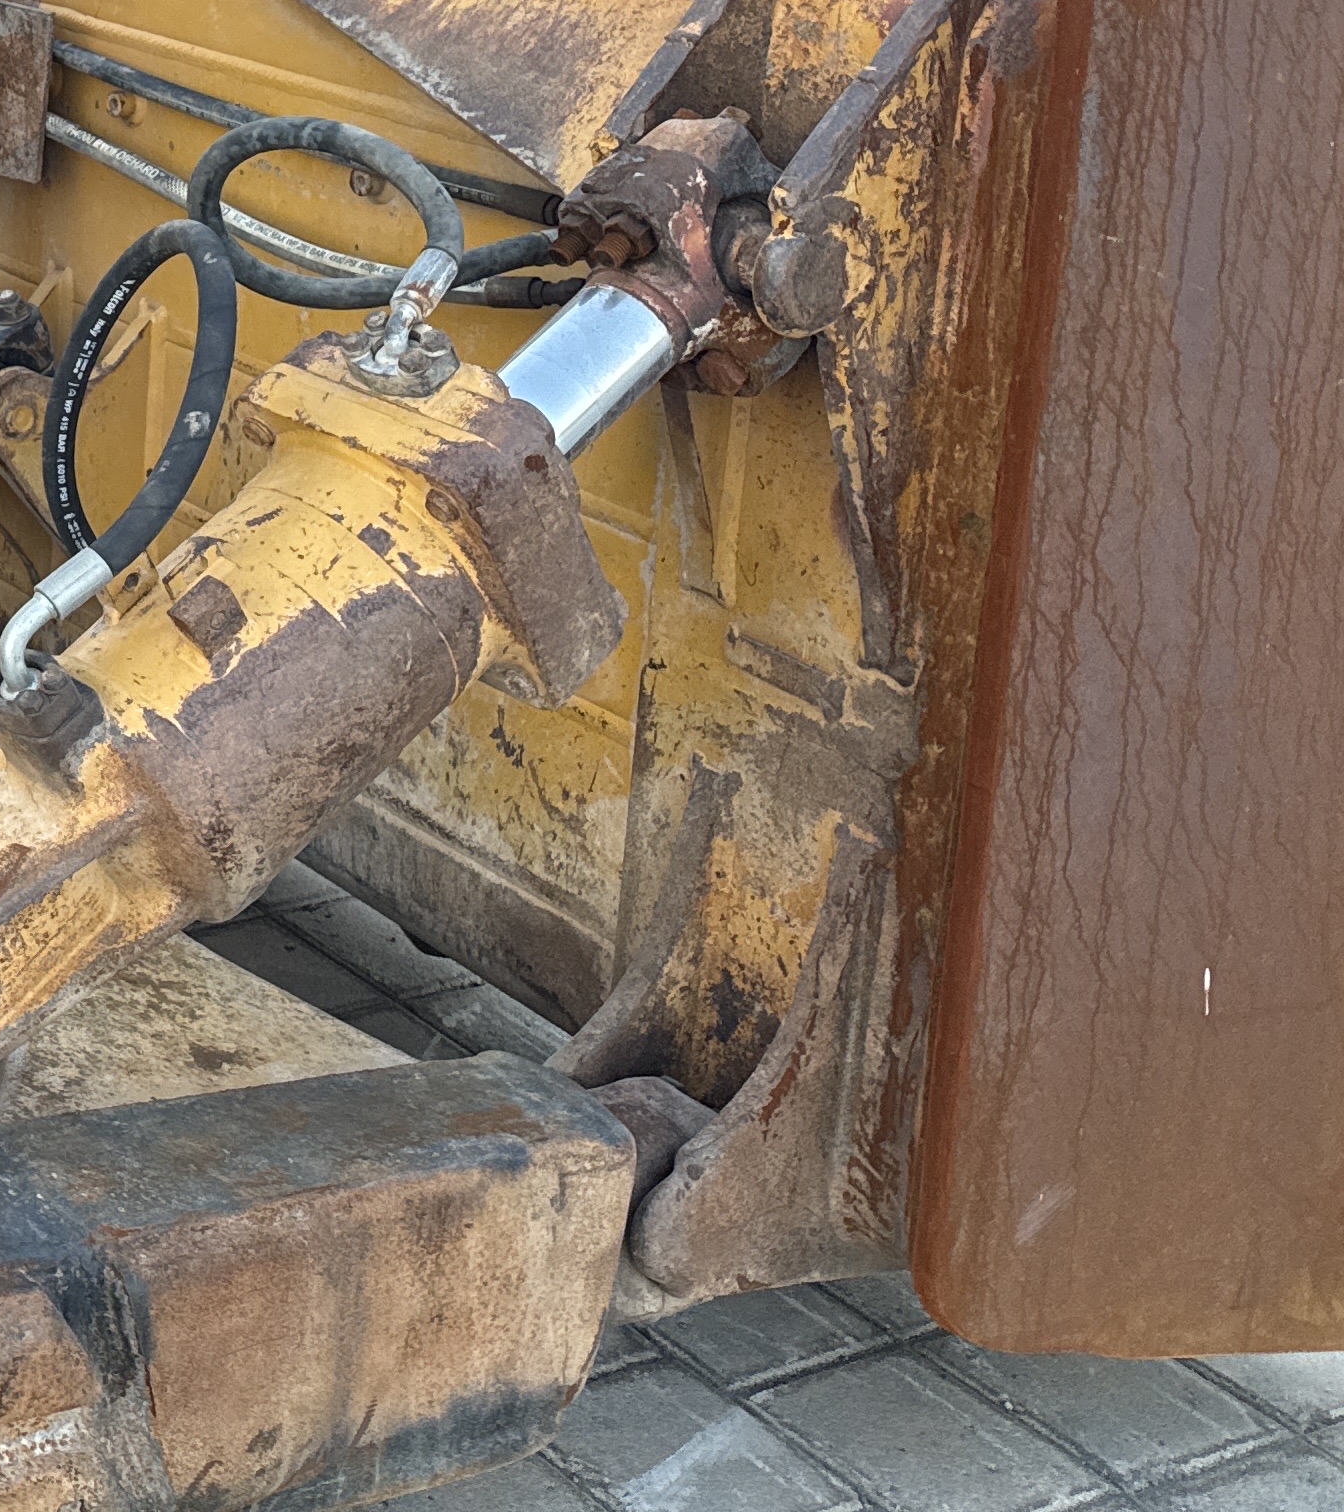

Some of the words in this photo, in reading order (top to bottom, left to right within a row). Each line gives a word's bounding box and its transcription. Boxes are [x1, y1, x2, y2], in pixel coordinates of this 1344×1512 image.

[102, 284, 130, 315] Falcon
[89, 318, 107, 337] Italy
[63, 399, 74, 414] WP
[59, 415, 69, 431] 415
[57, 433, 68, 453] BAR
